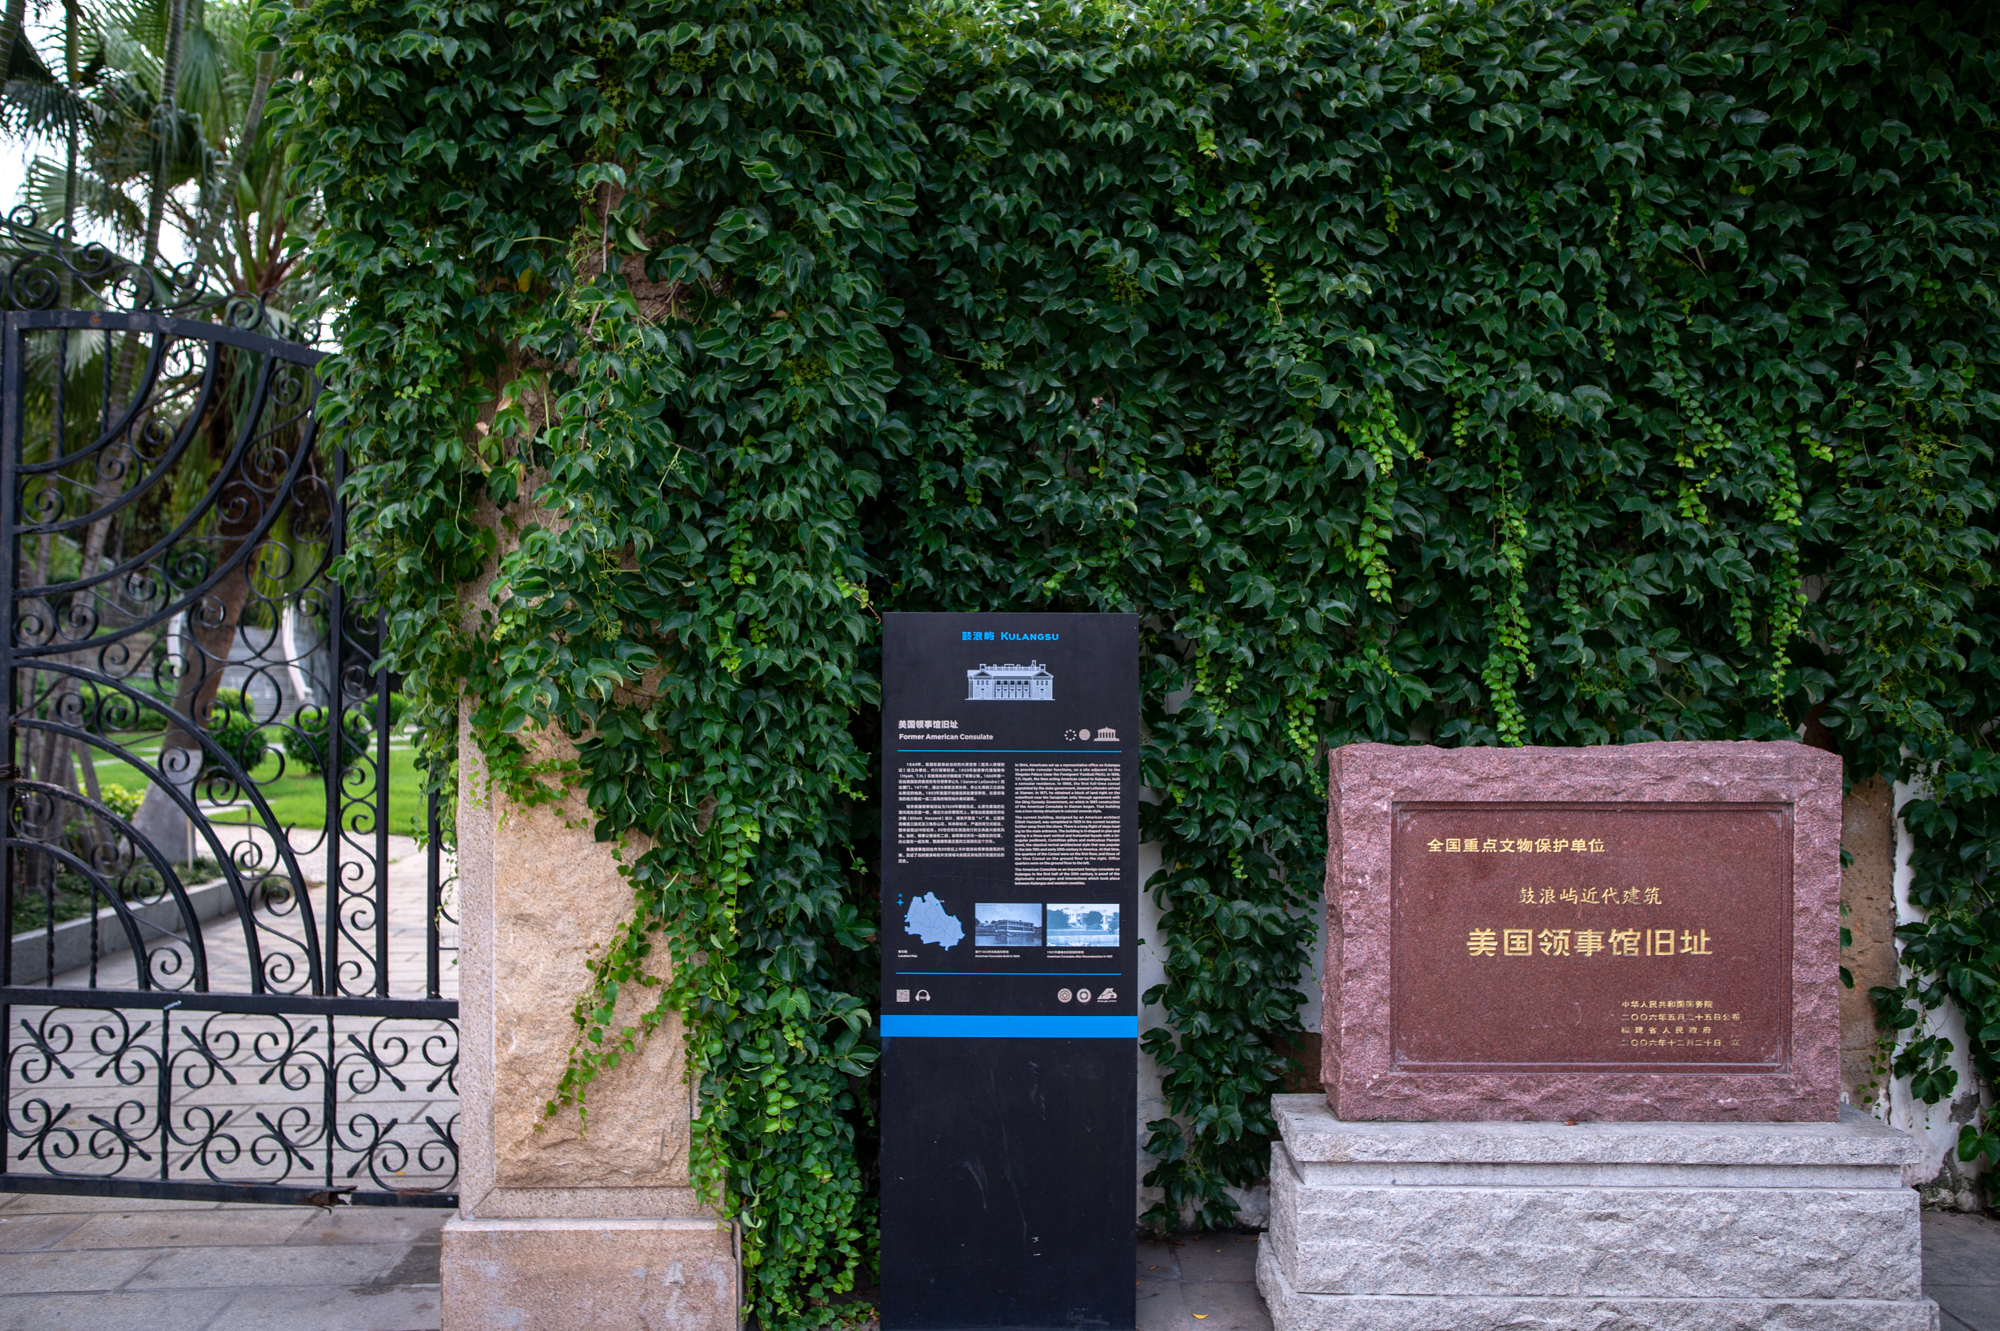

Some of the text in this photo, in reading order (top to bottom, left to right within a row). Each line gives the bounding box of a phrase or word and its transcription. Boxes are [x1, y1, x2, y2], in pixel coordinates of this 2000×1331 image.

[962, 631, 1059, 641] 鼓浪屿 KULANGSU
[898, 719, 959, 729] 美国领事馆旧址
[899, 733, 994, 741] Former American Consulate
[1427, 837, 1606, 853] 全国重点文物保护单位
[1518, 886, 1663, 905] 鼓浪屿近代建筑
[1465, 927, 1713, 957] 美国领事馆旧址
[1621, 1000, 1713, 1009] 中华人民共和国国务院
